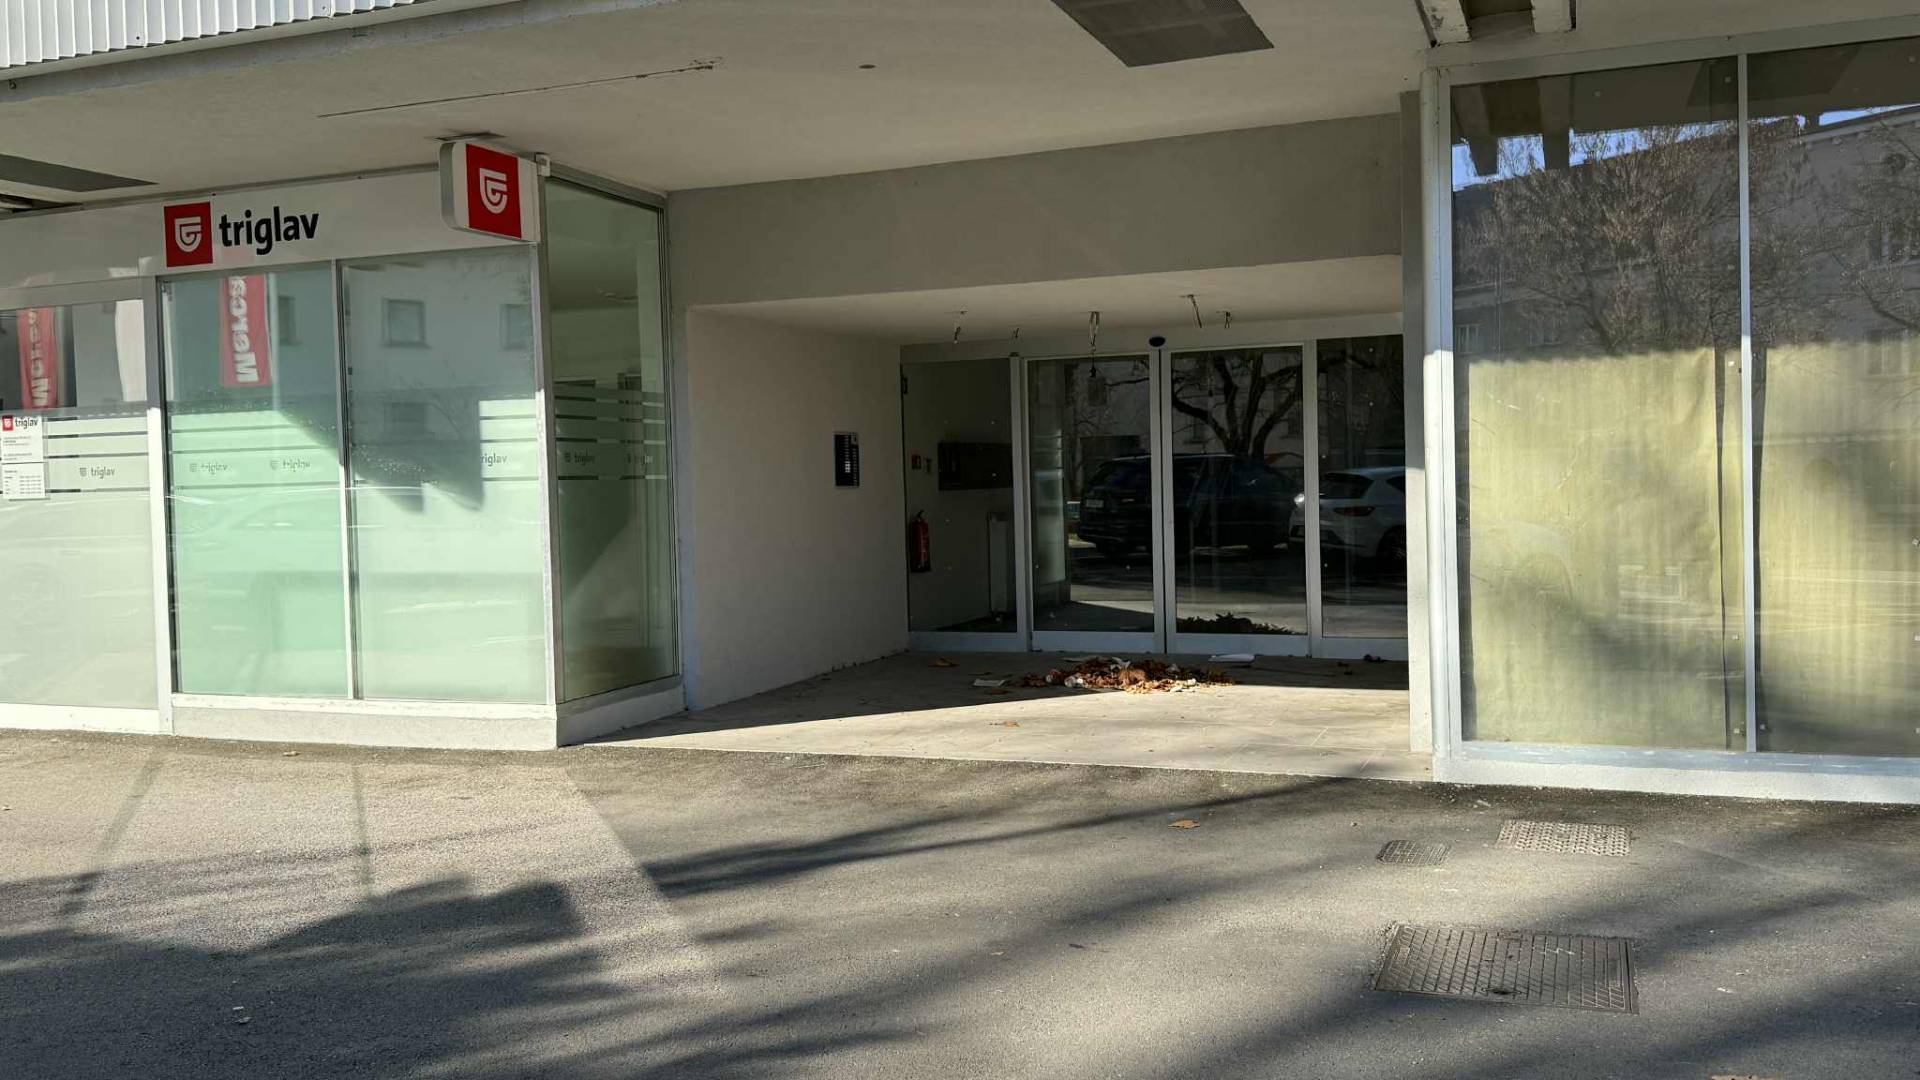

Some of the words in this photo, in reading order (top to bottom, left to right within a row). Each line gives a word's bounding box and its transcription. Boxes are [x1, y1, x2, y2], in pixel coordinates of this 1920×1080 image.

[219, 206, 319, 255] triglav
[15, 418, 38, 430] triglav
[91, 467, 115, 479] triglav
